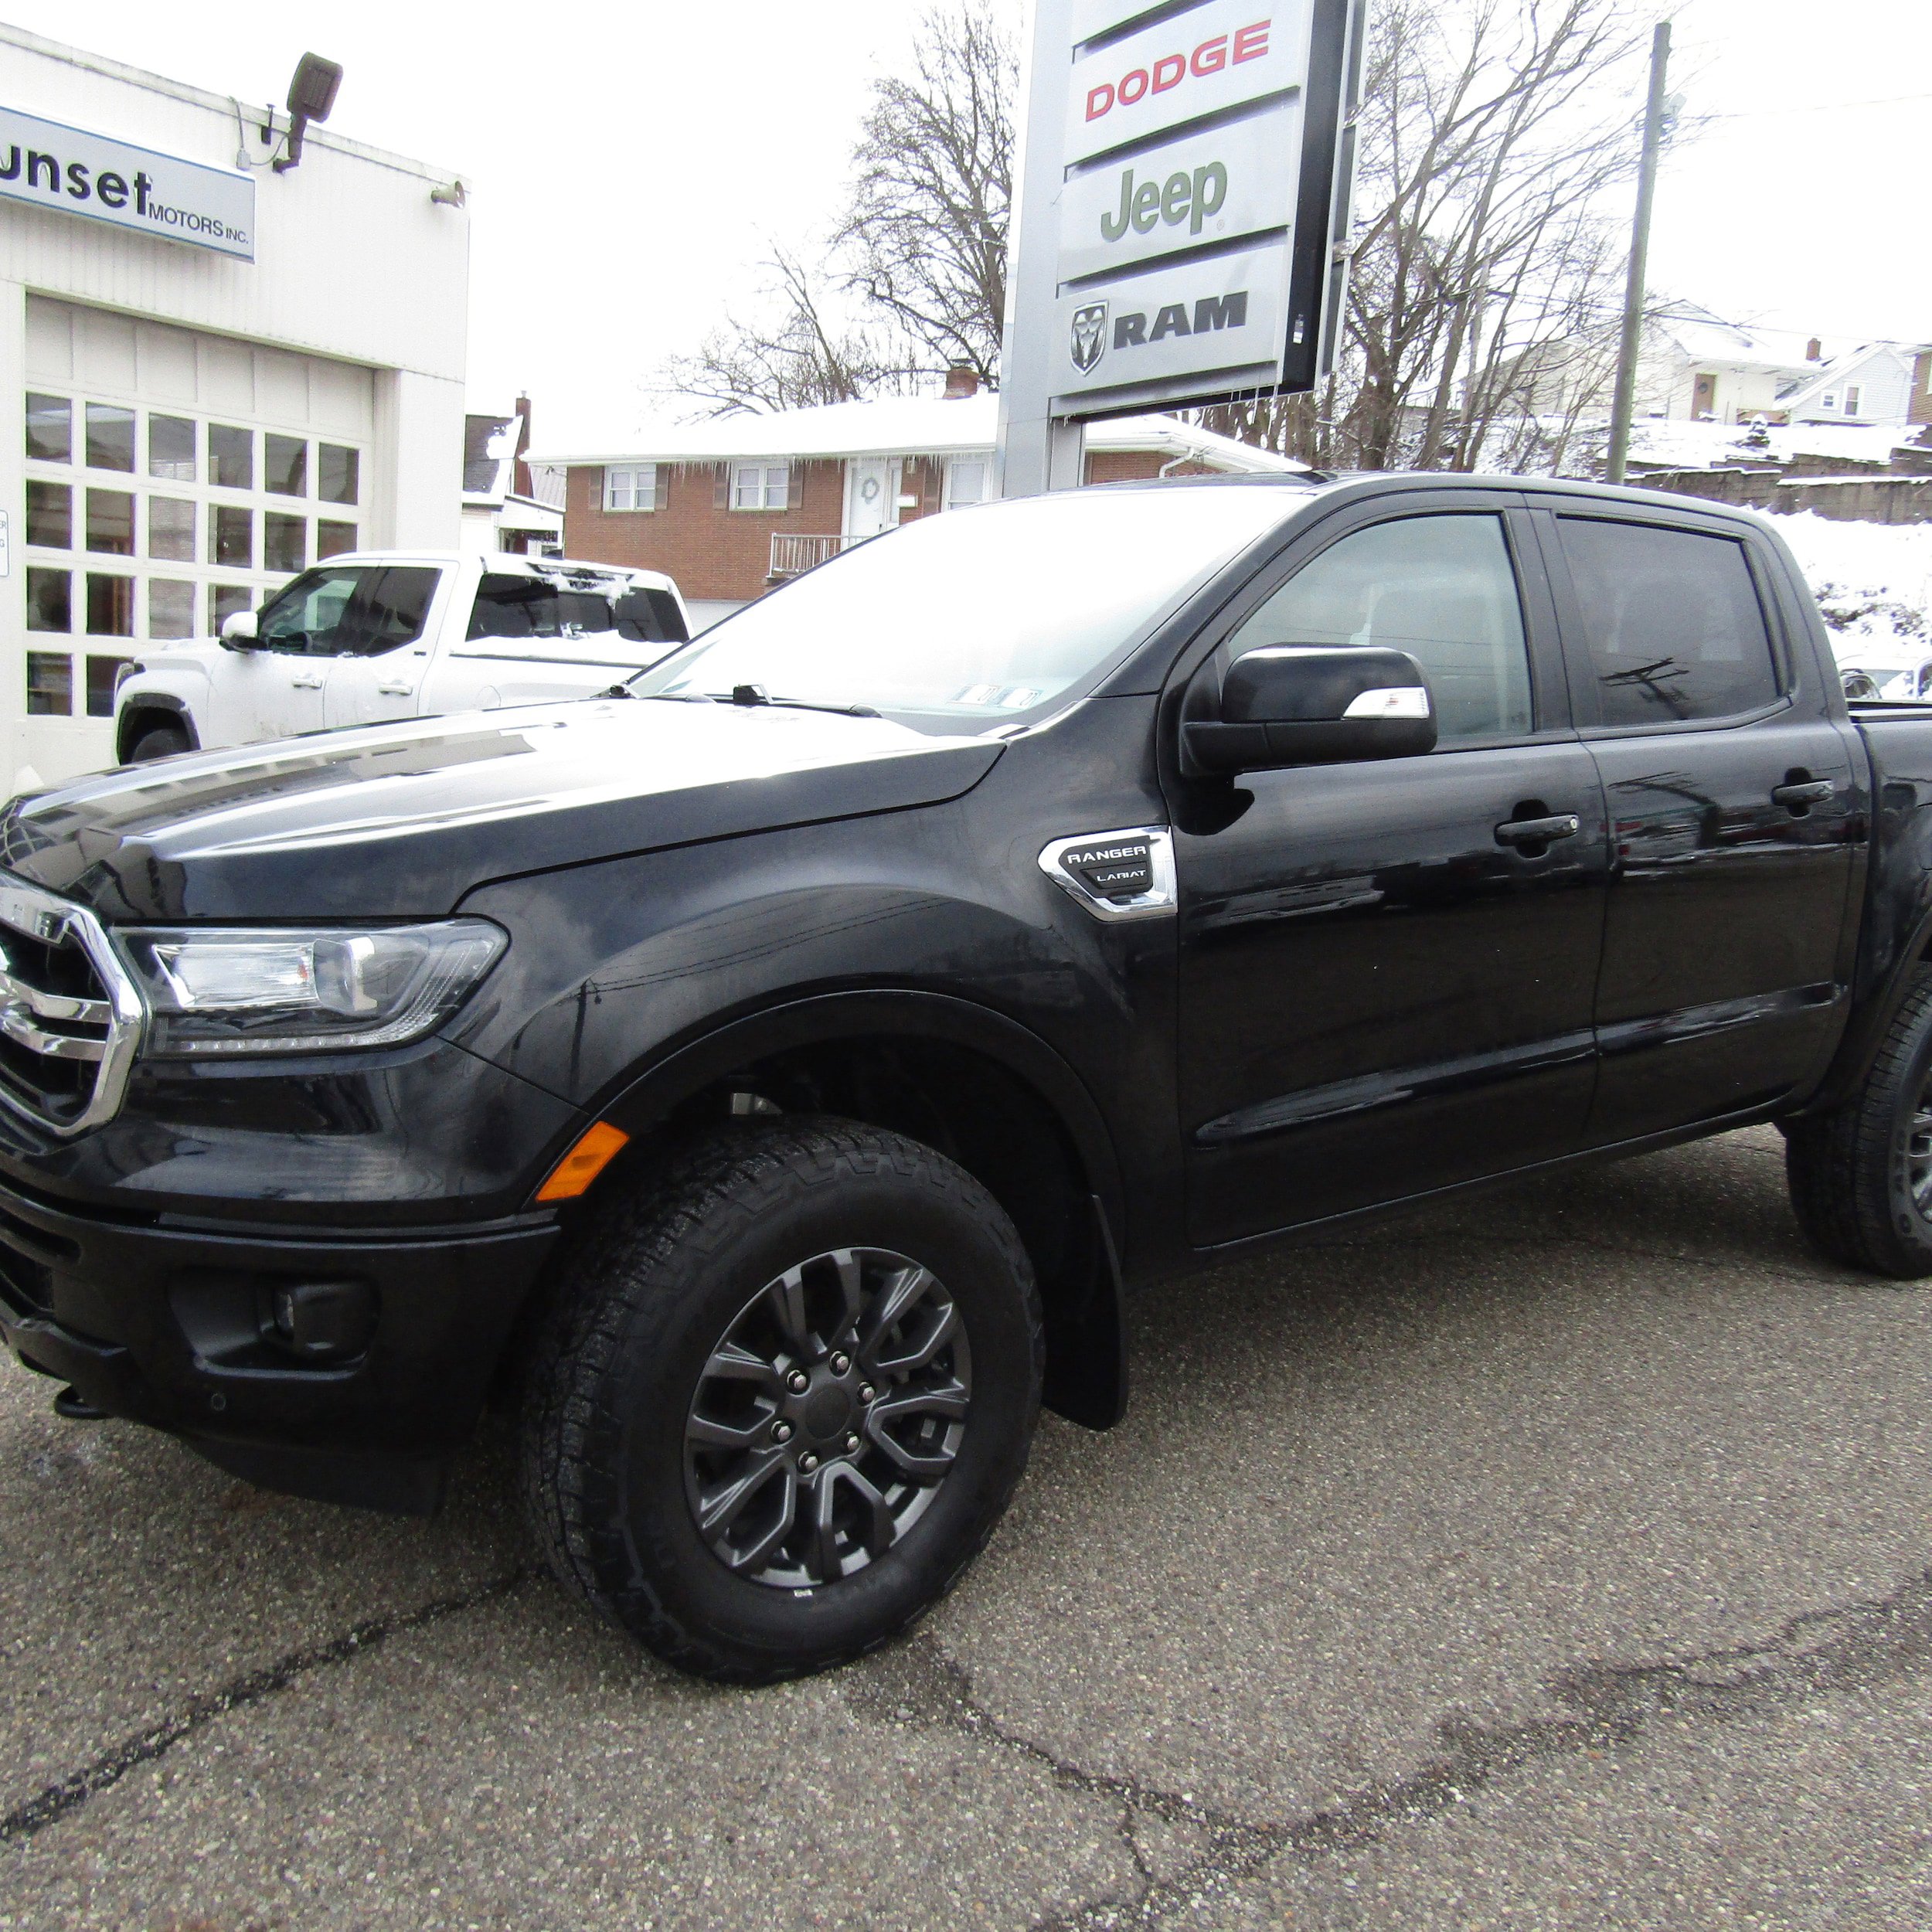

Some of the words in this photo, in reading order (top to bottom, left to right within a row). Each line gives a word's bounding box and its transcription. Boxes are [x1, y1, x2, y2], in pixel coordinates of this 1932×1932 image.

[1085, 20, 1272, 122] DODGE
[149, 203, 223, 236] MOTORS
[226, 228, 249, 244] INC.
[1100, 161, 1228, 243] Jeep
[1113, 291, 1249, 349] RAM
[1067, 845, 1147, 864] RANGER
[1097, 869, 1145, 882] LARIAT
